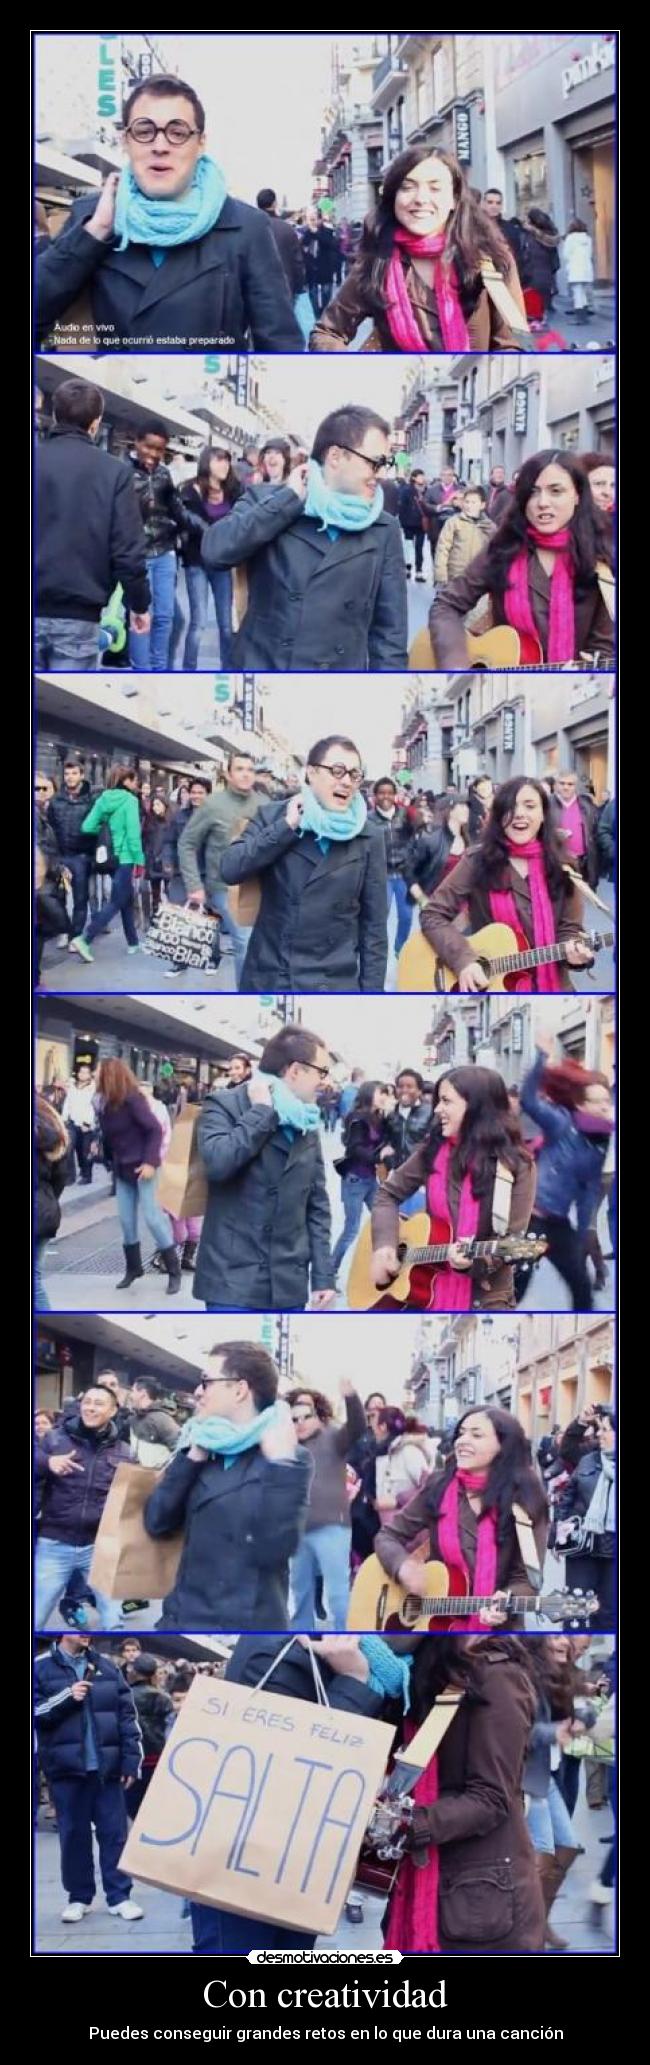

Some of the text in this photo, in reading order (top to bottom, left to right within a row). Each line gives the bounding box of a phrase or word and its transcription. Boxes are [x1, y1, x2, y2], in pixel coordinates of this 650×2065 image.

[457, 112, 470, 161] MANGO
[504, 712, 514, 750] MANGO
[202, 1697, 365, 1747] SI ERES FELIZ
[138, 1736, 366, 1905] SALTA
